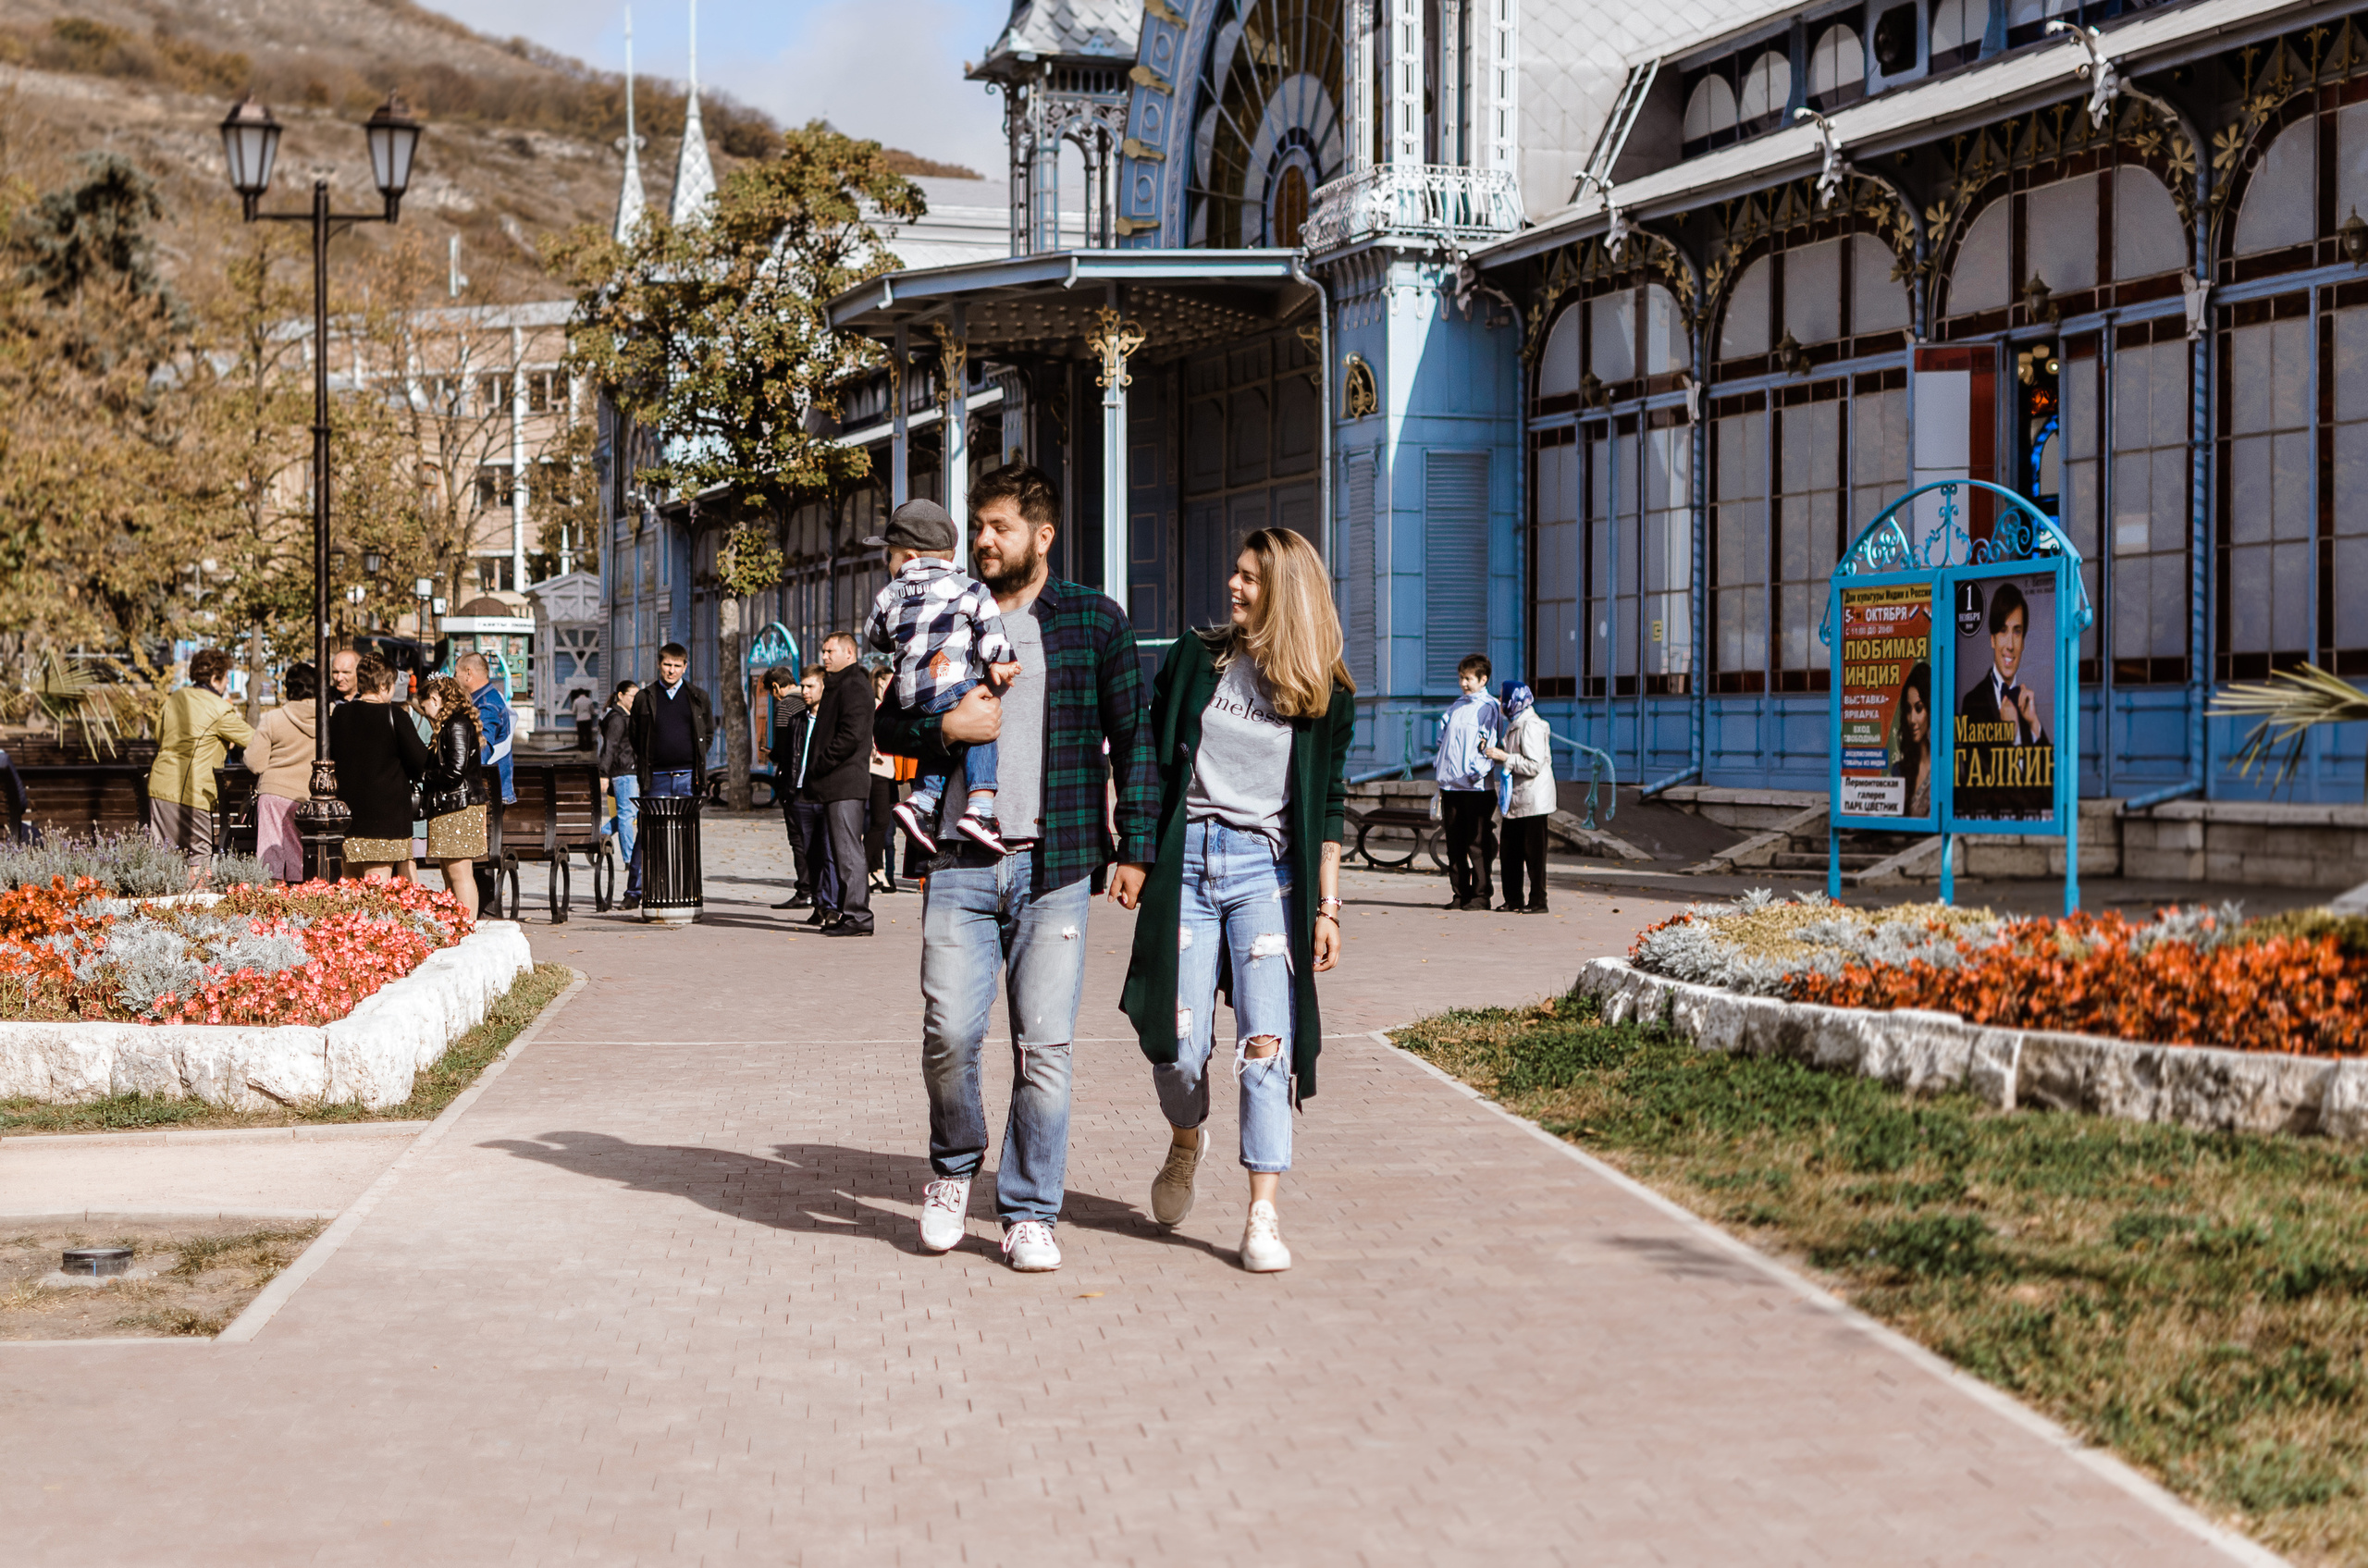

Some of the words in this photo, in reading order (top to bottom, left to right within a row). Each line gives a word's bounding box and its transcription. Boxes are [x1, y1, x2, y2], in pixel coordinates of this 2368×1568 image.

[1967, 585, 1972, 611] 1
[1866, 607, 1907, 622] ОКТЯБРЯ
[1844, 636, 1928, 661] ЛЮБИМАЯ
[1844, 664, 1900, 689] ИНДИЯ
[1844, 695, 1890, 705] ВЫСТАВКА-
[1844, 710, 1880, 719] ЯРМАРКА
[1853, 725, 1870, 734] ВХОД
[1954, 715, 2016, 743] Максим
[1844, 734, 1881, 743] СВОБОДНЫЙ
[1954, 746, 2054, 787] ГАЛКИН
[1857, 792, 1886, 801] галерея
[1844, 800, 1863, 810] ПАРК
[1864, 801, 1898, 812] ЦВЕТНИК
